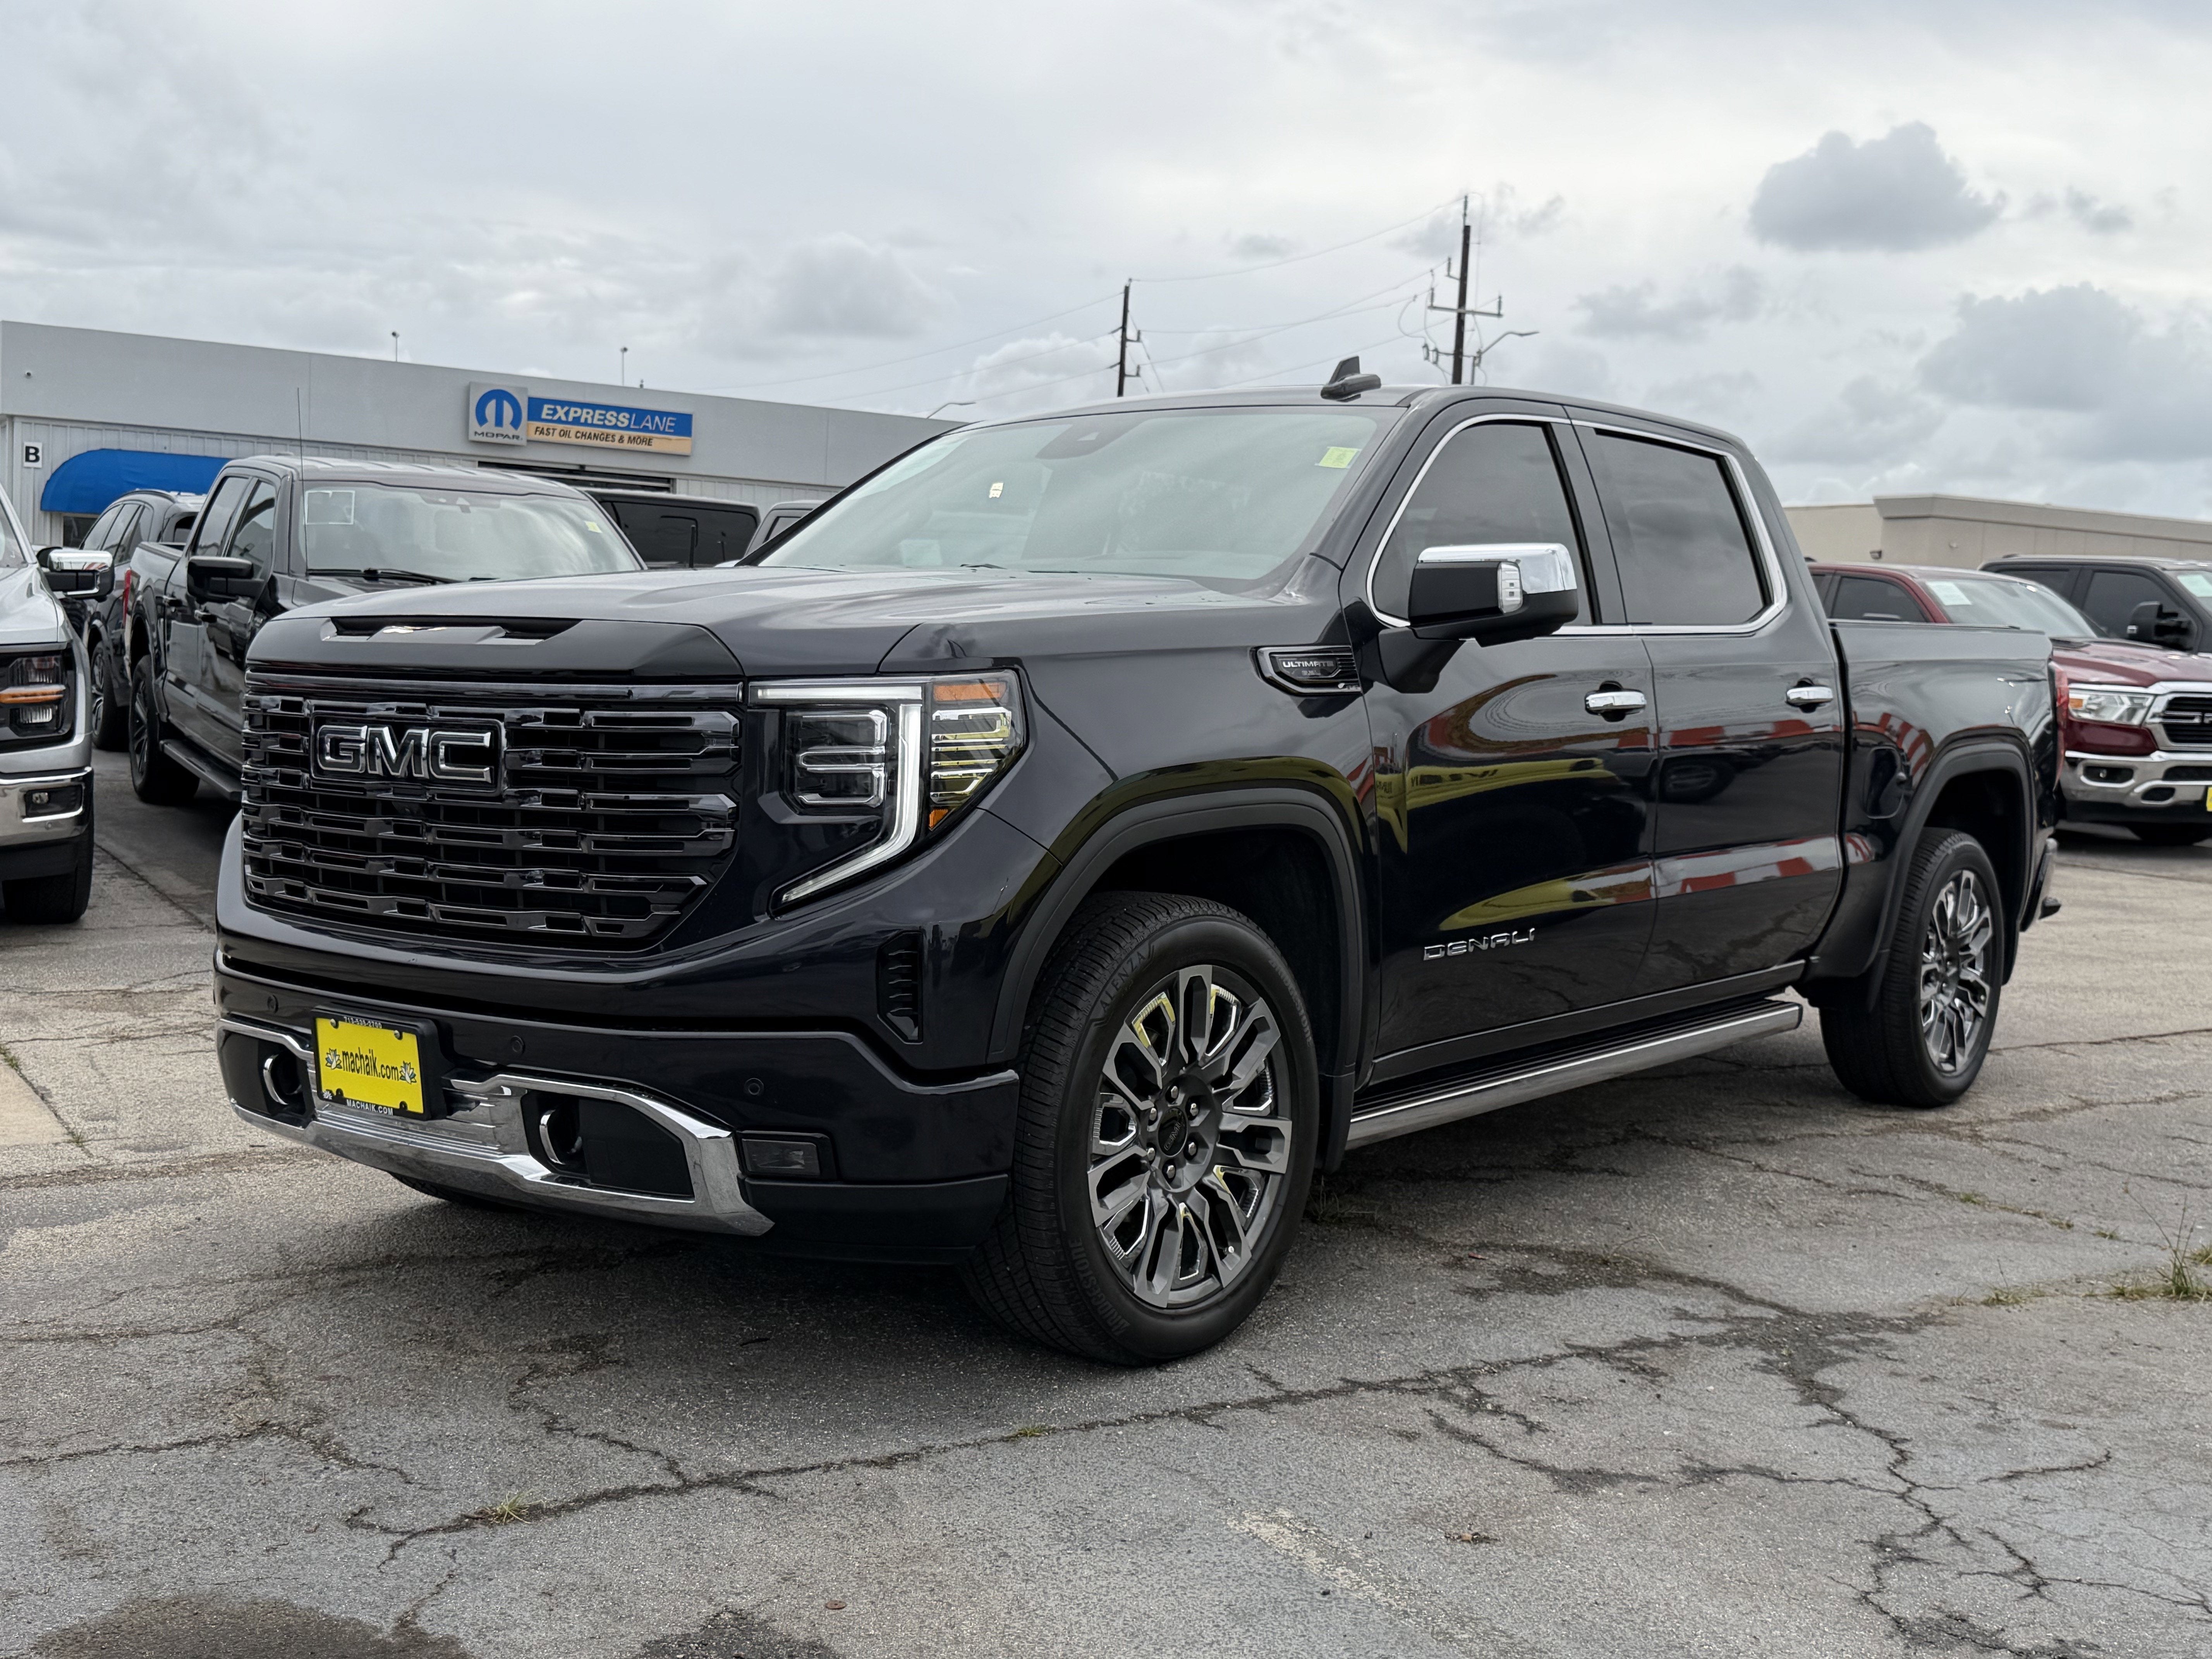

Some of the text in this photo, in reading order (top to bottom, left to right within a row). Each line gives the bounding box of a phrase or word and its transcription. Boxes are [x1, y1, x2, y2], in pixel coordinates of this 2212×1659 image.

[474, 431, 520, 441] MOPAR
[534, 426, 653, 447] FAST OIL CHANGES & MORE
[25, 446, 40, 462] B
[317, 725, 492, 783] GMC
[1423, 928, 1535, 961] DENALI
[1100, 951, 1147, 1012] ALENZA
[342, 1047, 399, 1081] machaik.com
[346, 1099, 393, 1116] MACHAIK.COM
